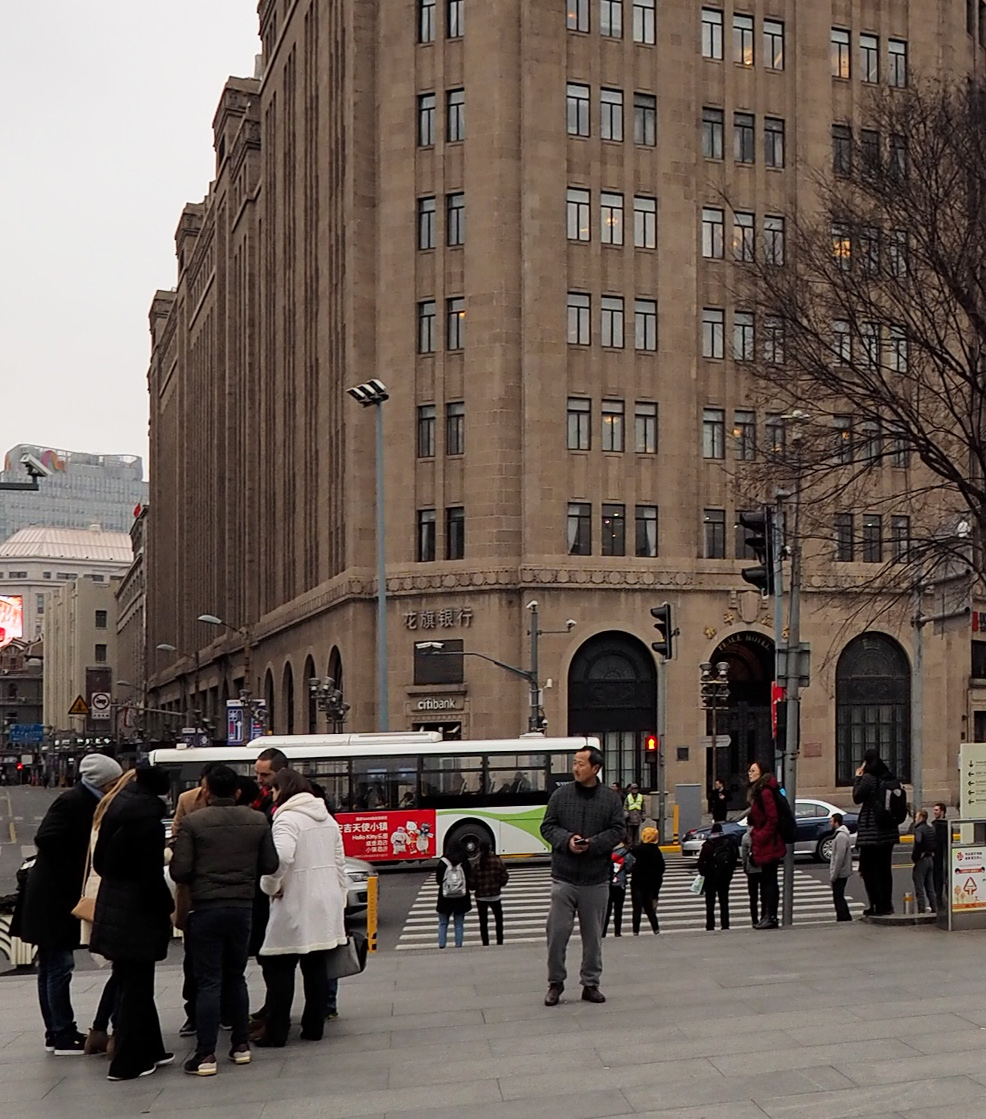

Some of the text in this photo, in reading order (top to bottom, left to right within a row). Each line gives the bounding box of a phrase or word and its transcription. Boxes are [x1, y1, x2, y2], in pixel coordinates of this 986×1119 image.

[403, 607, 473, 630] 花旗银行
[417, 698, 456, 710] citibank
